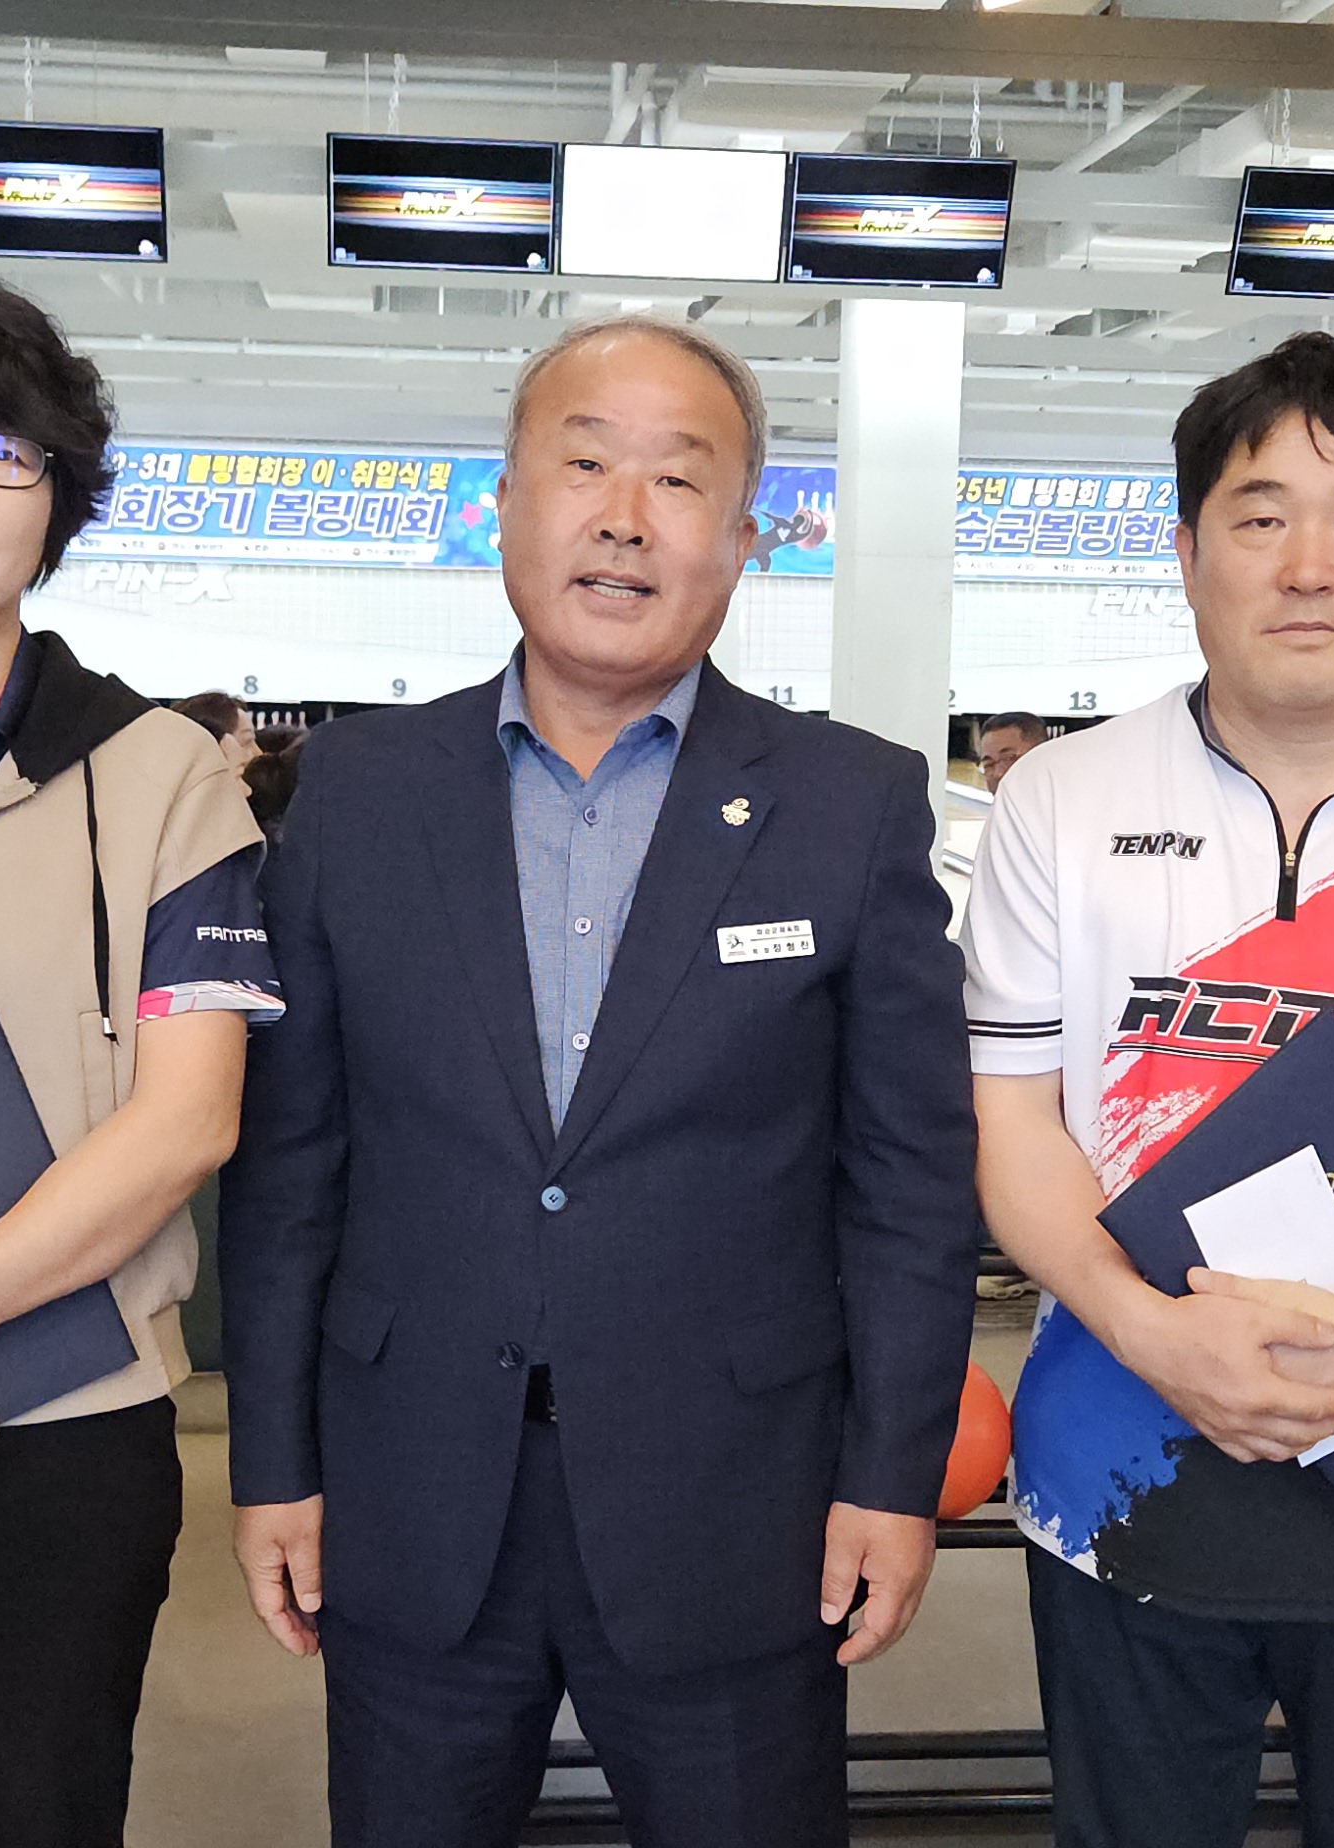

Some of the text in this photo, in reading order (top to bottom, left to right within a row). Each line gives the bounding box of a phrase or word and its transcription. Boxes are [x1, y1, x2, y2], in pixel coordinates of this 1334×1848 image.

[427, 462, 452, 492] 및
[956, 475, 1008, 506] 25년
[1104, 478, 1153, 510] 통합
[87, 483, 449, 540] 회장기 볼링대회
[243, 674, 259, 695] 8
[391, 677, 407, 698] 9
[768, 685, 797, 706] 11
[1068, 690, 1097, 711] 13
